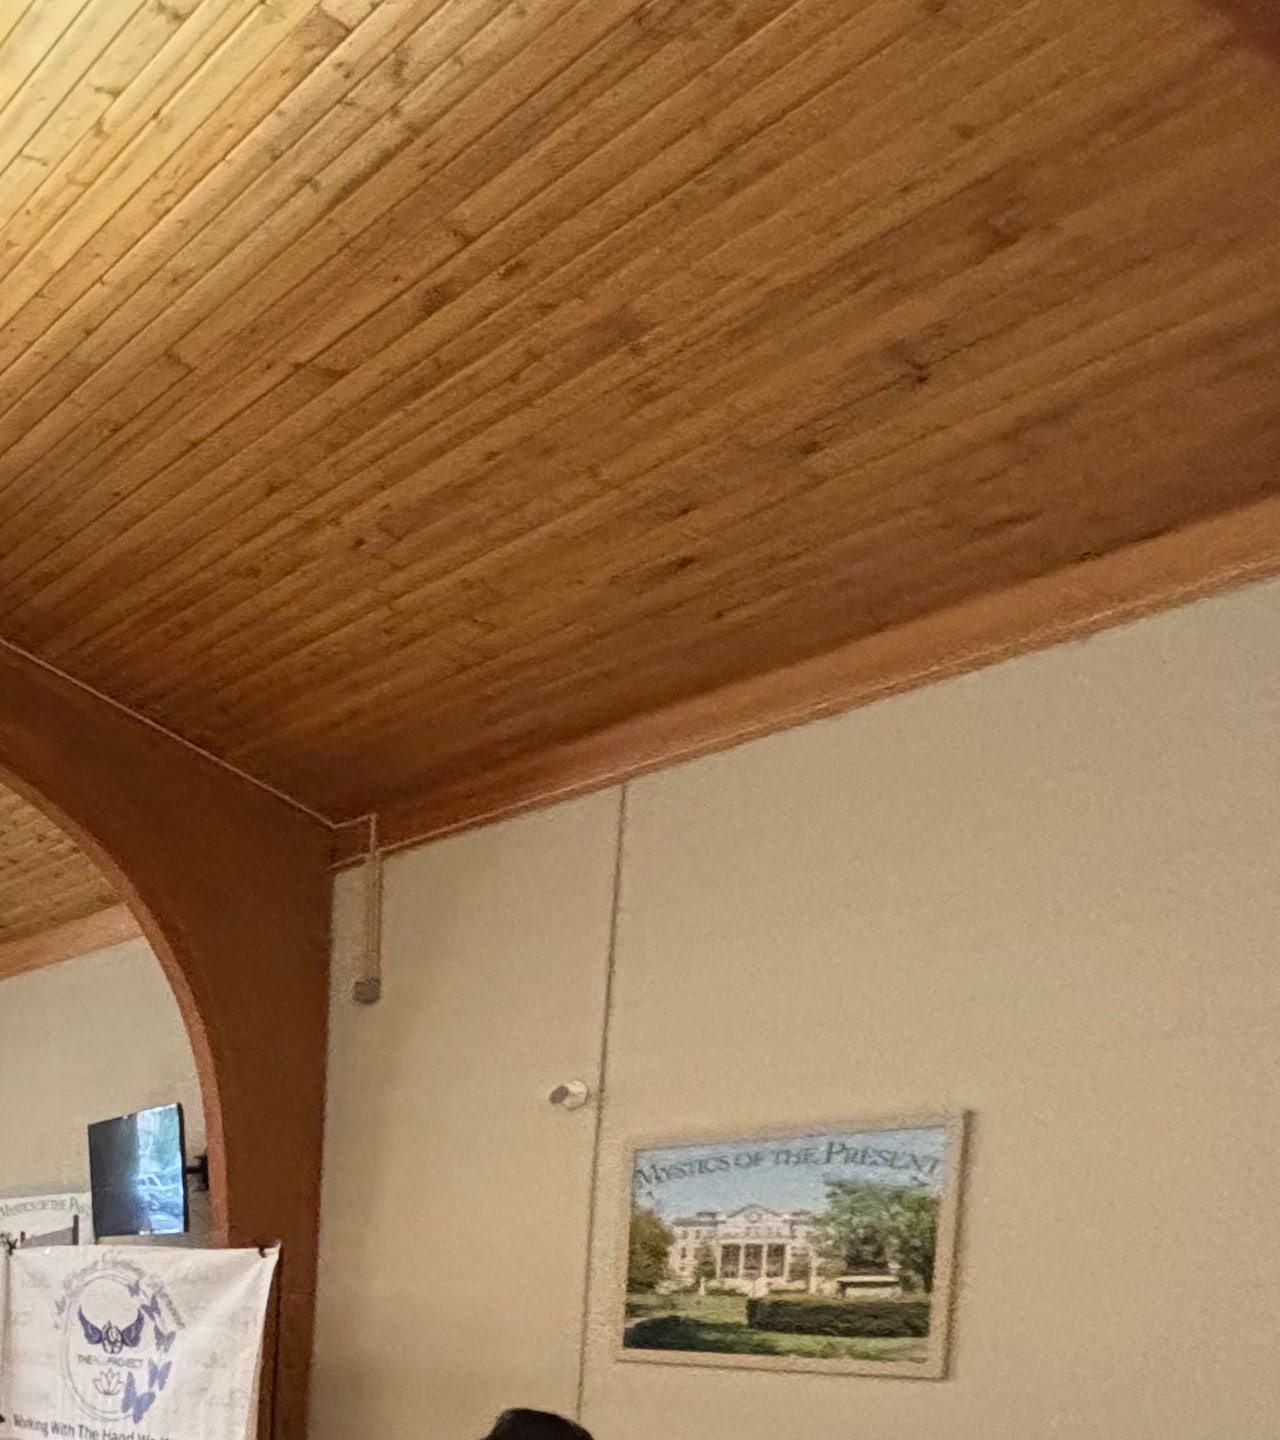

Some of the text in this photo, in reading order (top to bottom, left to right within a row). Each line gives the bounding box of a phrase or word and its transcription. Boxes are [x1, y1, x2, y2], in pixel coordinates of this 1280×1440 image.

[635, 1140, 940, 1186] MYSTICS OF THE PRESENT
[13, 1413, 49, 1437] Working
[51, 1421, 75, 1438] With
[78, 1424, 99, 1440] The
